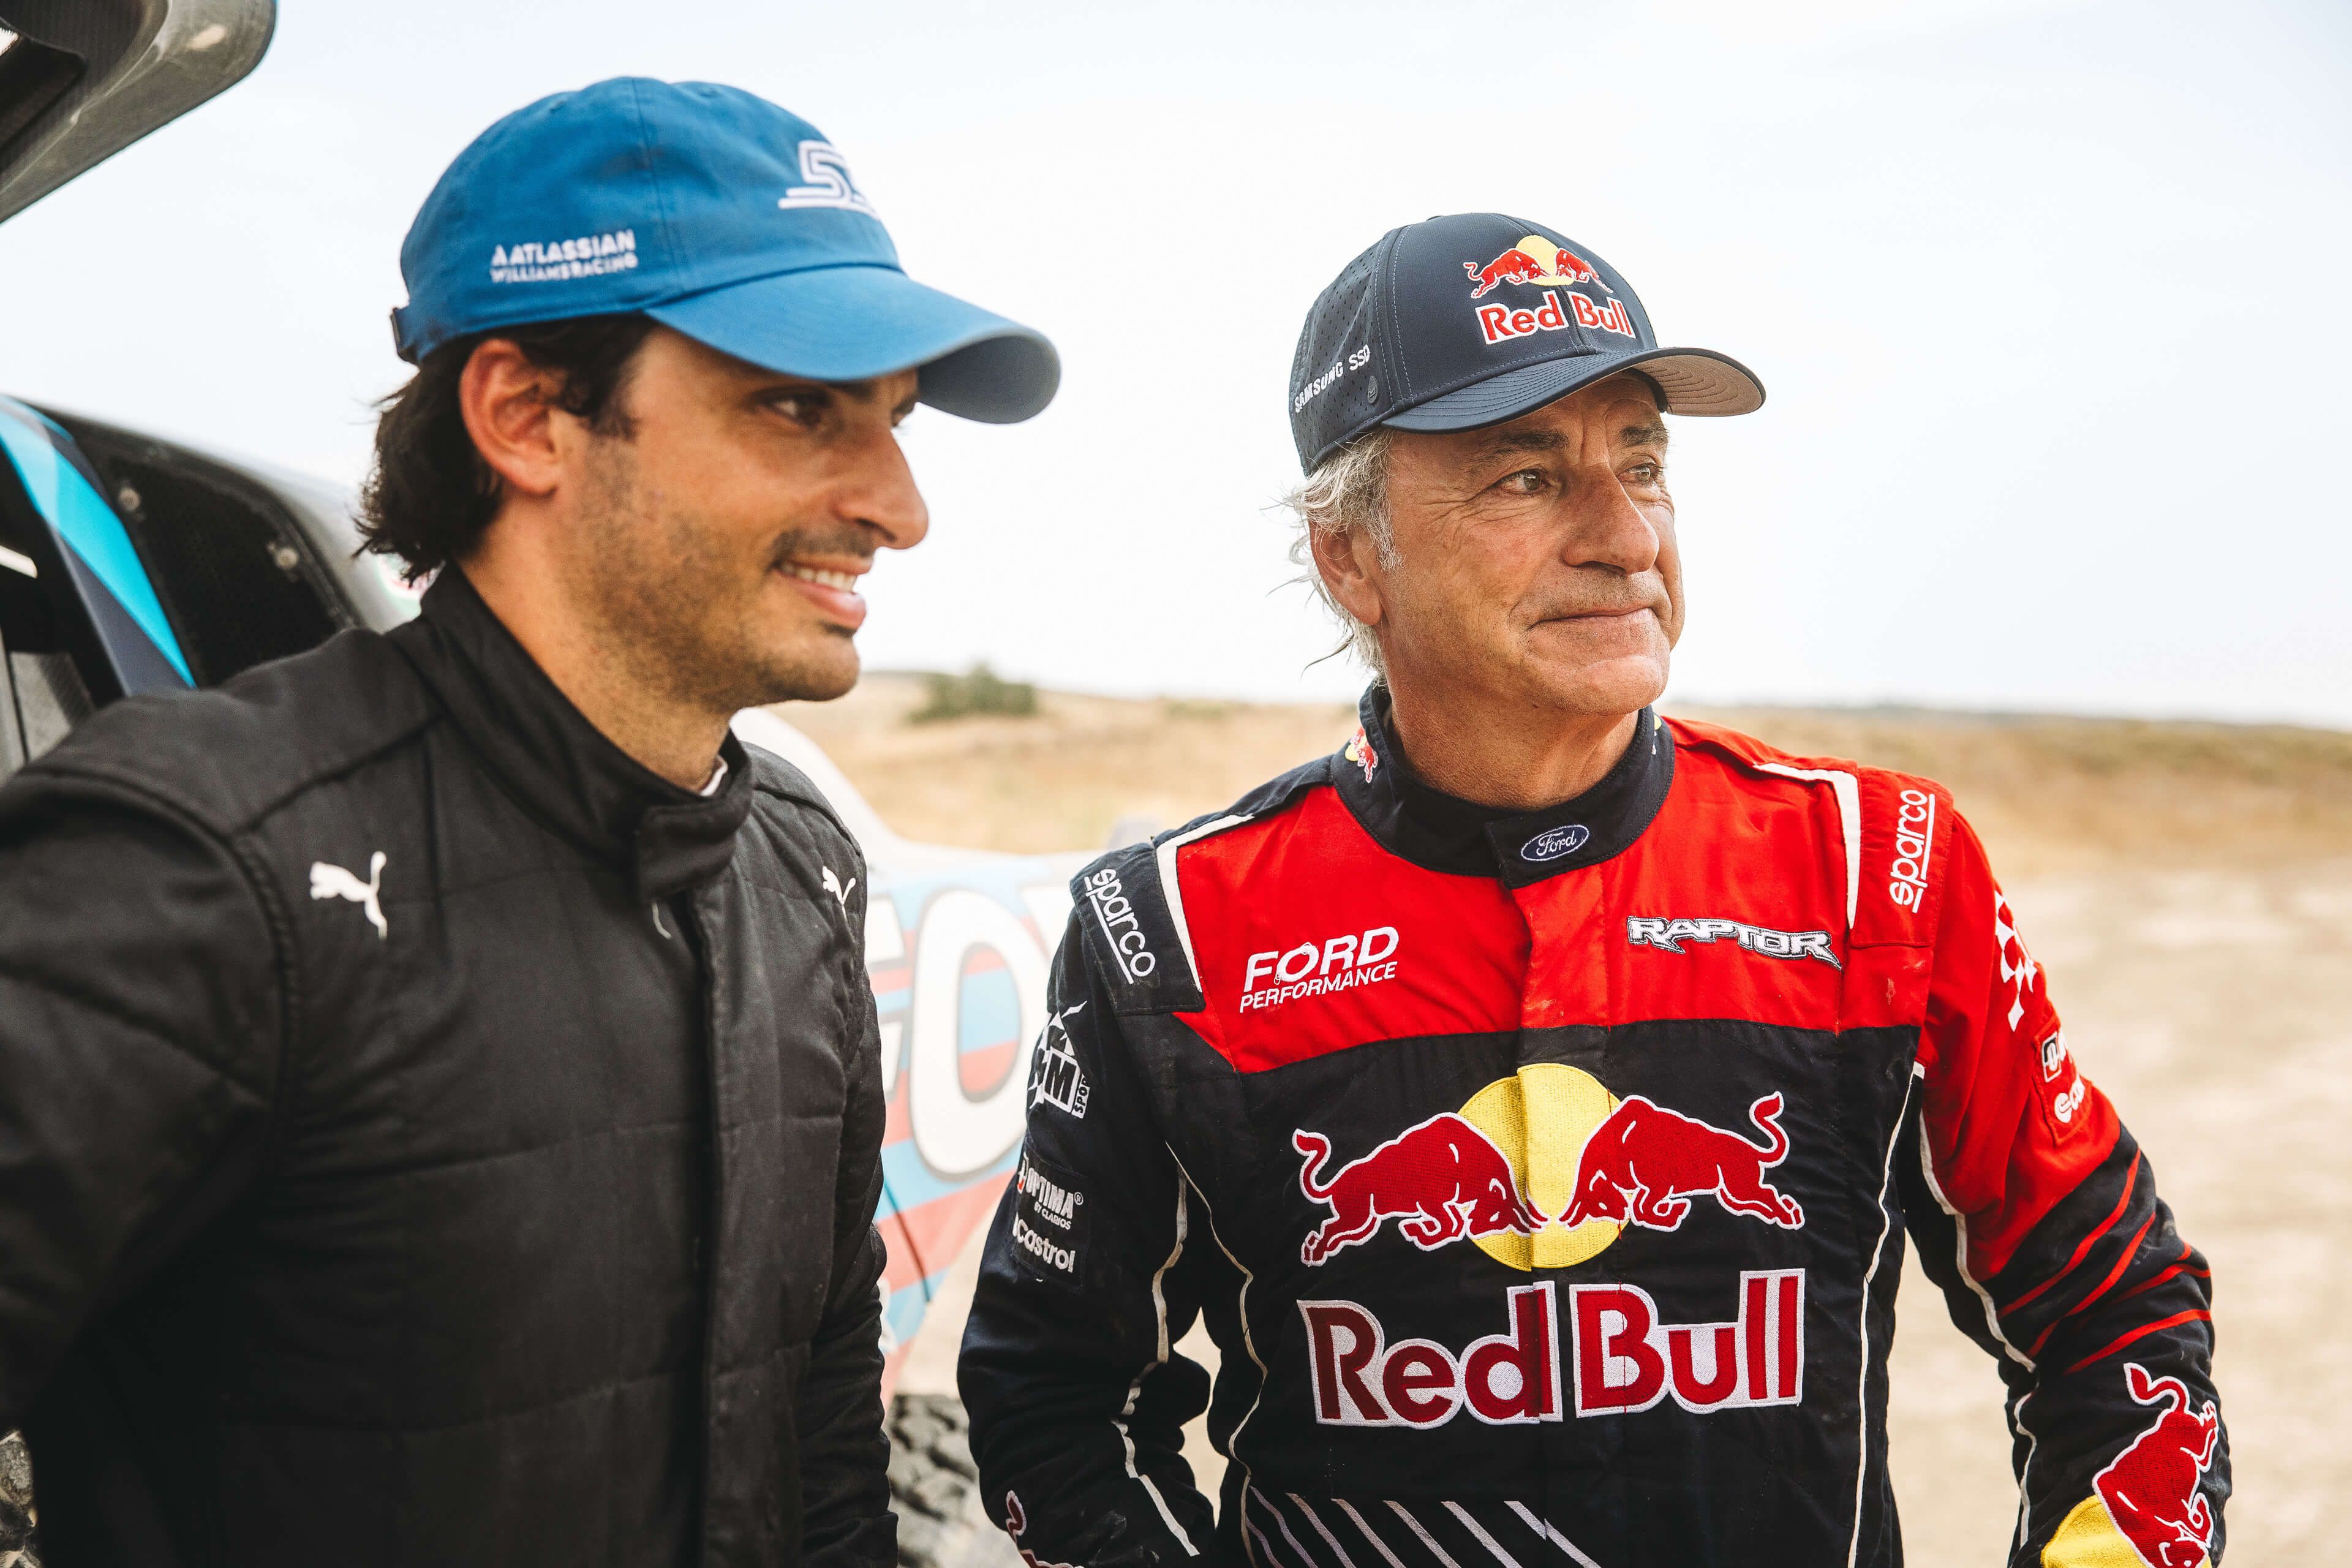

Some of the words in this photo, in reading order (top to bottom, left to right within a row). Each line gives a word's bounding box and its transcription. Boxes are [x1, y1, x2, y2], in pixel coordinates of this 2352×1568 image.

[1475, 290, 1568, 345] Red
[1567, 291, 1636, 339] Bull
[1294, 361, 1343, 413] SAMSUNG
[1349, 344, 1371, 371] SSD
[1536, 830, 1577, 856] Ford
[1890, 790, 1929, 908] sparco
[1086, 869, 1156, 978] sparco
[1626, 915, 1842, 970] RAPTOR
[1243, 926, 1400, 987] FORD
[1239, 961, 1398, 1014] PERFORMANCE
[1297, 1280, 1562, 1429] Red
[1570, 1268, 1806, 1418] Bull
